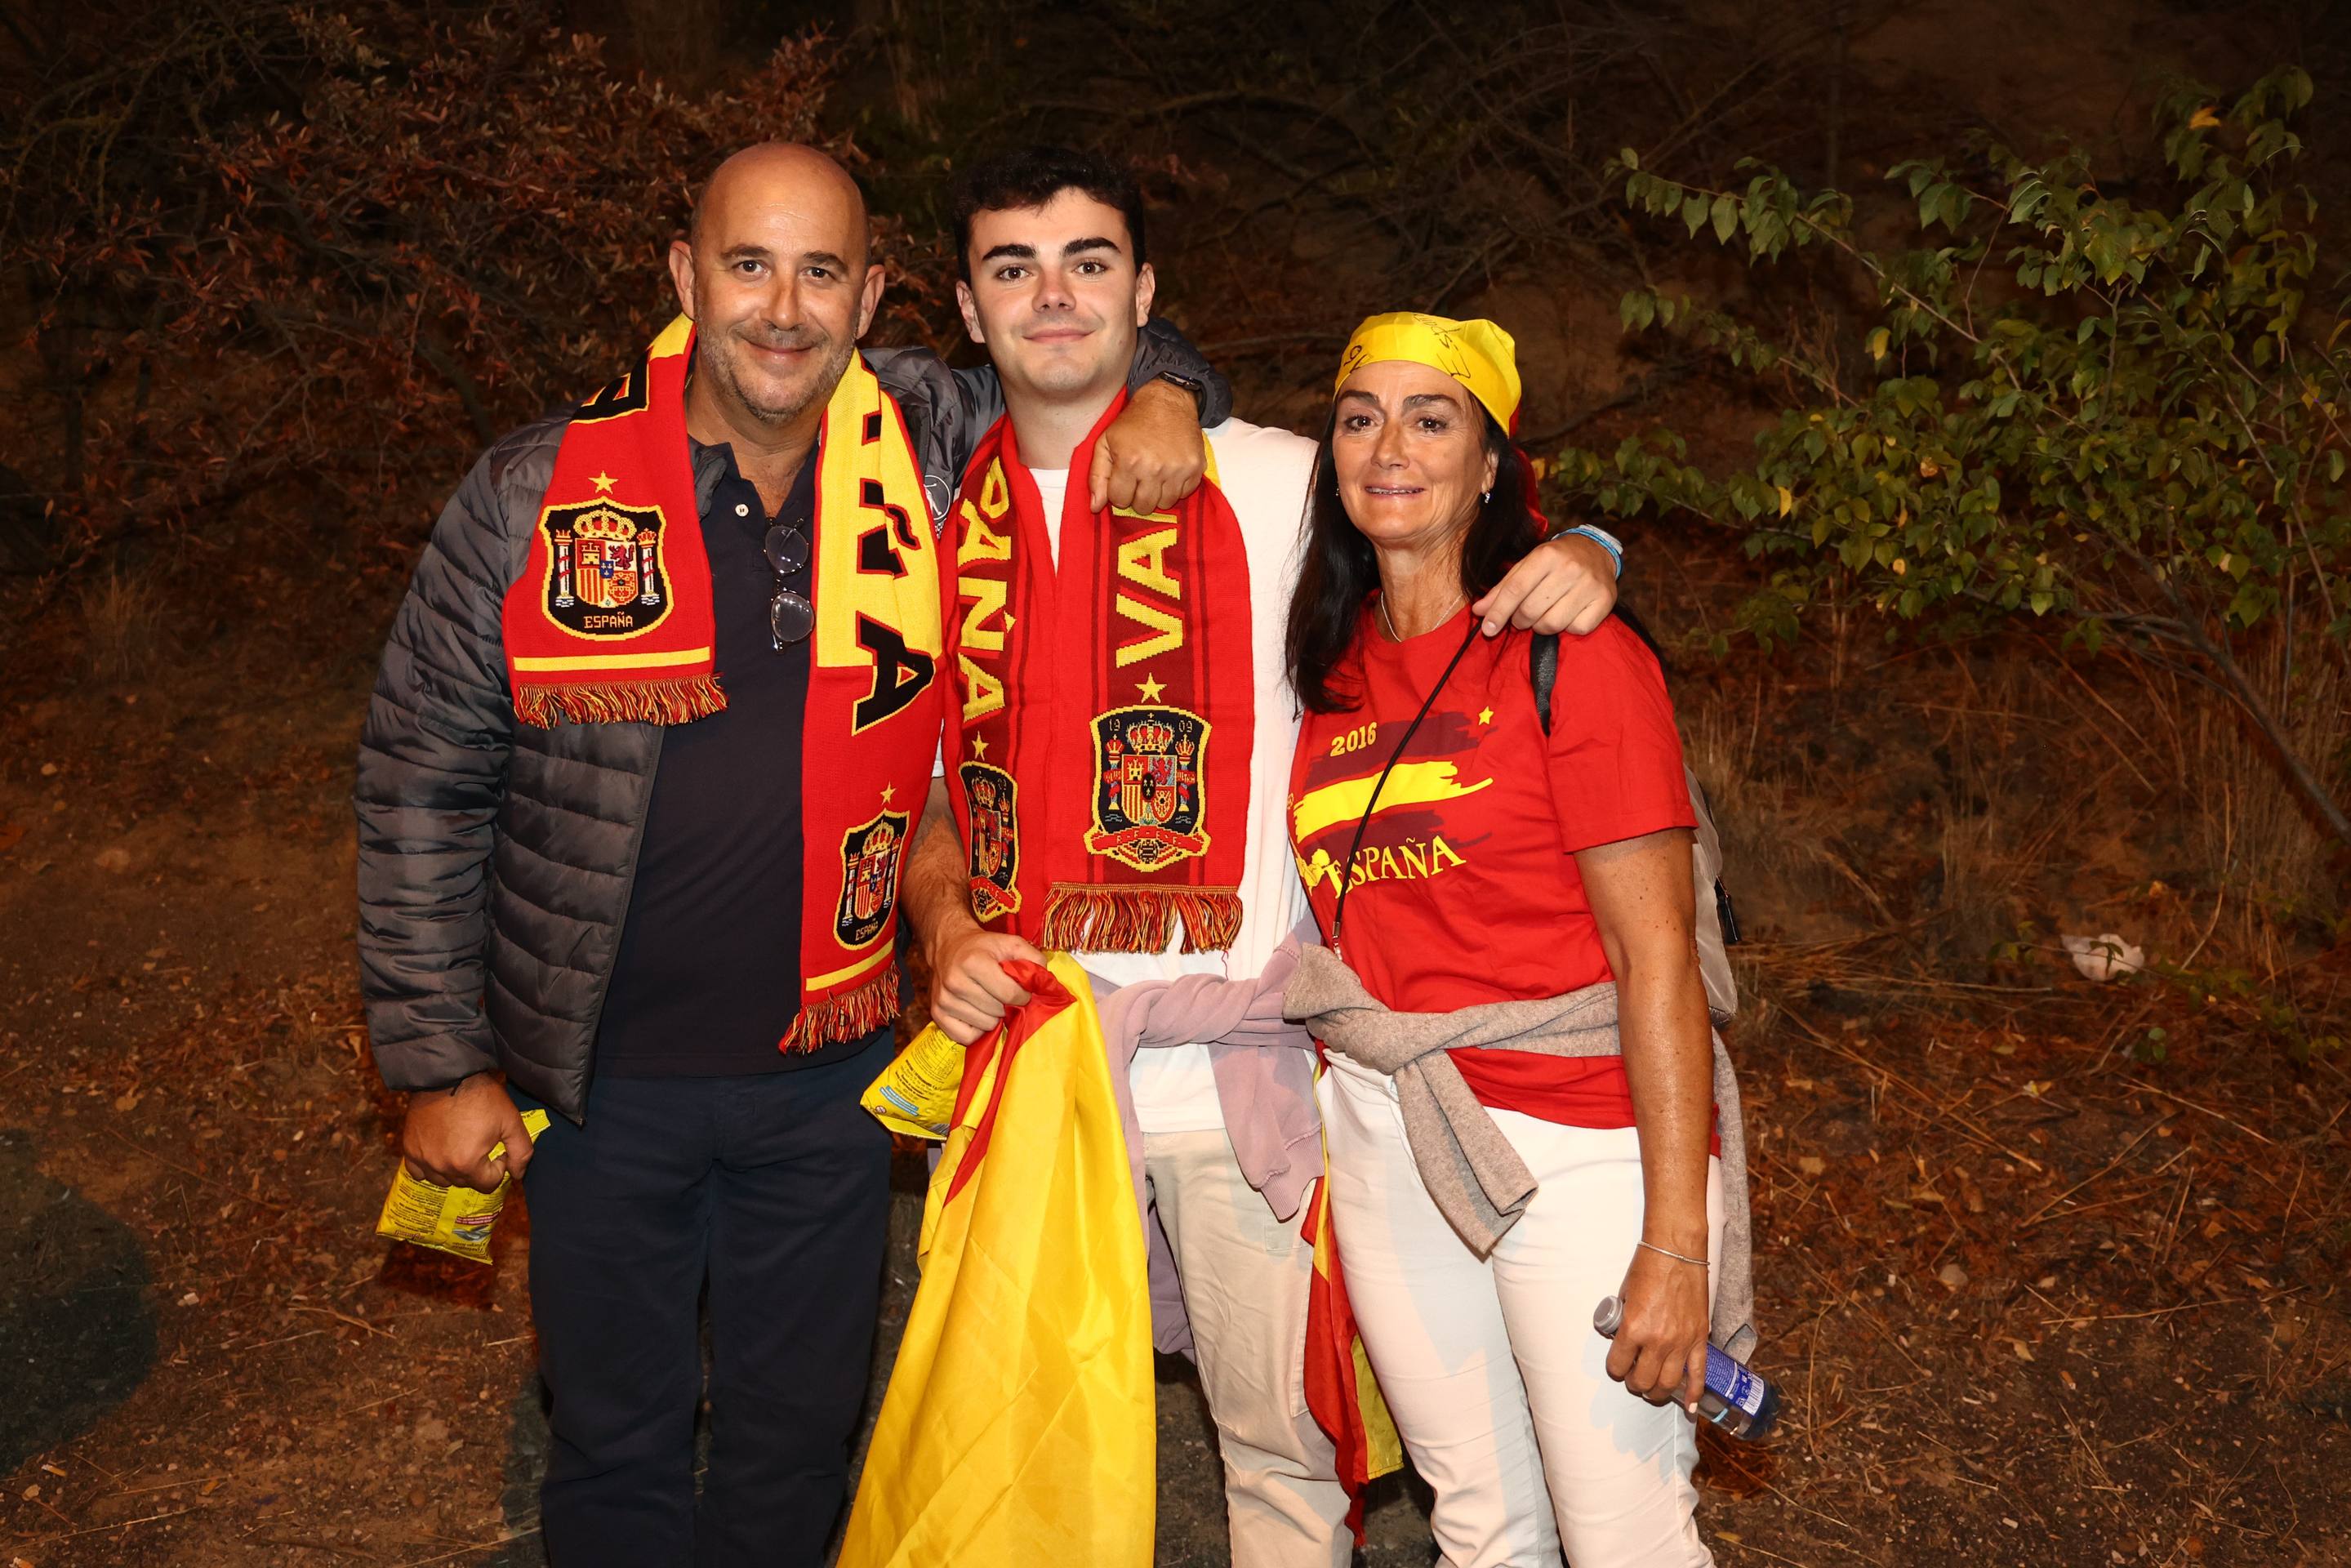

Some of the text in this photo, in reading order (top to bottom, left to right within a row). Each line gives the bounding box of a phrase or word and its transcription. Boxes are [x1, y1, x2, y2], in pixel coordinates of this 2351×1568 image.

[1111, 504, 1184, 669] VA
[583, 611, 634, 629] ESPAÑA
[1329, 722, 1378, 757] 2016
[1323, 835, 1467, 899] ESPAÑA
